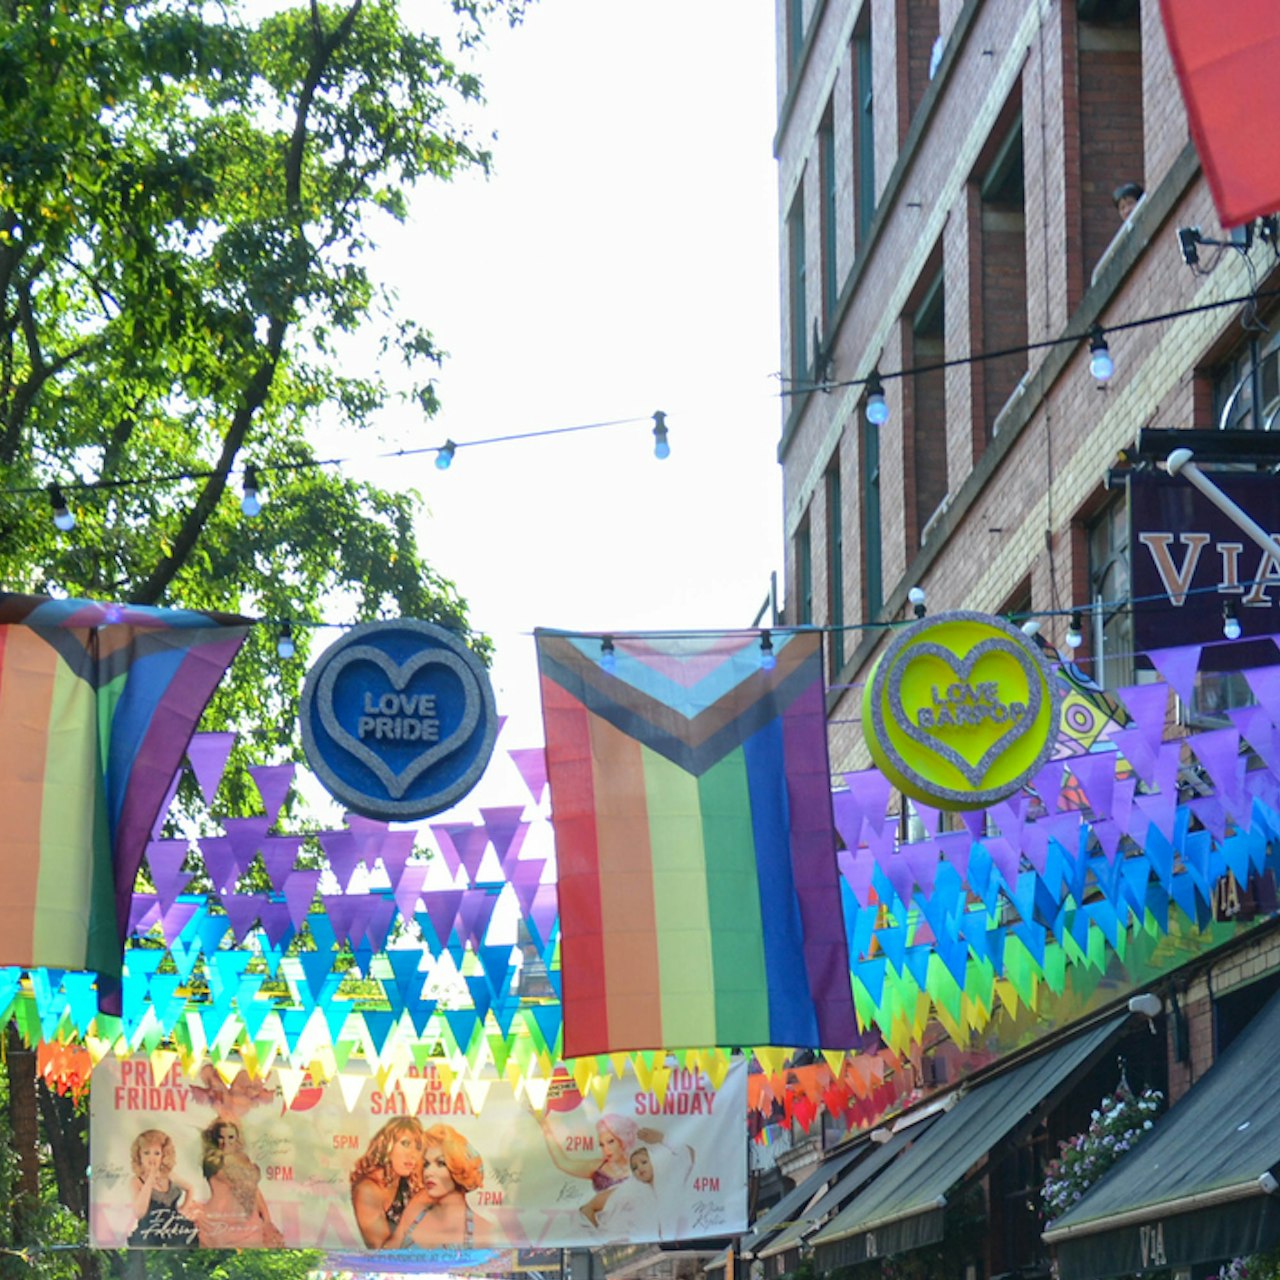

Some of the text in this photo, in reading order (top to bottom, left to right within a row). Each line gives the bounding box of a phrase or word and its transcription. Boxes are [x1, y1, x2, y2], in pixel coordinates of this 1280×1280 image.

[363, 691, 437, 716] LOVE
[931, 681, 999, 705] LOVE
[917, 701, 1028, 729] BARPOP
[358, 716, 440, 741] PRIDE
[115, 1087, 189, 1112] FRIDAY
[635, 1091, 716, 1116] SUNDAY
[332, 1135, 359, 1150] 5PM
[566, 1136, 594, 1152] 2PM
[266, 1166, 294, 1181] 9PM
[693, 1177, 720, 1193] 4PM
[477, 1191, 503, 1206] 7PM
[1140, 1222, 1167, 1268] VIA
